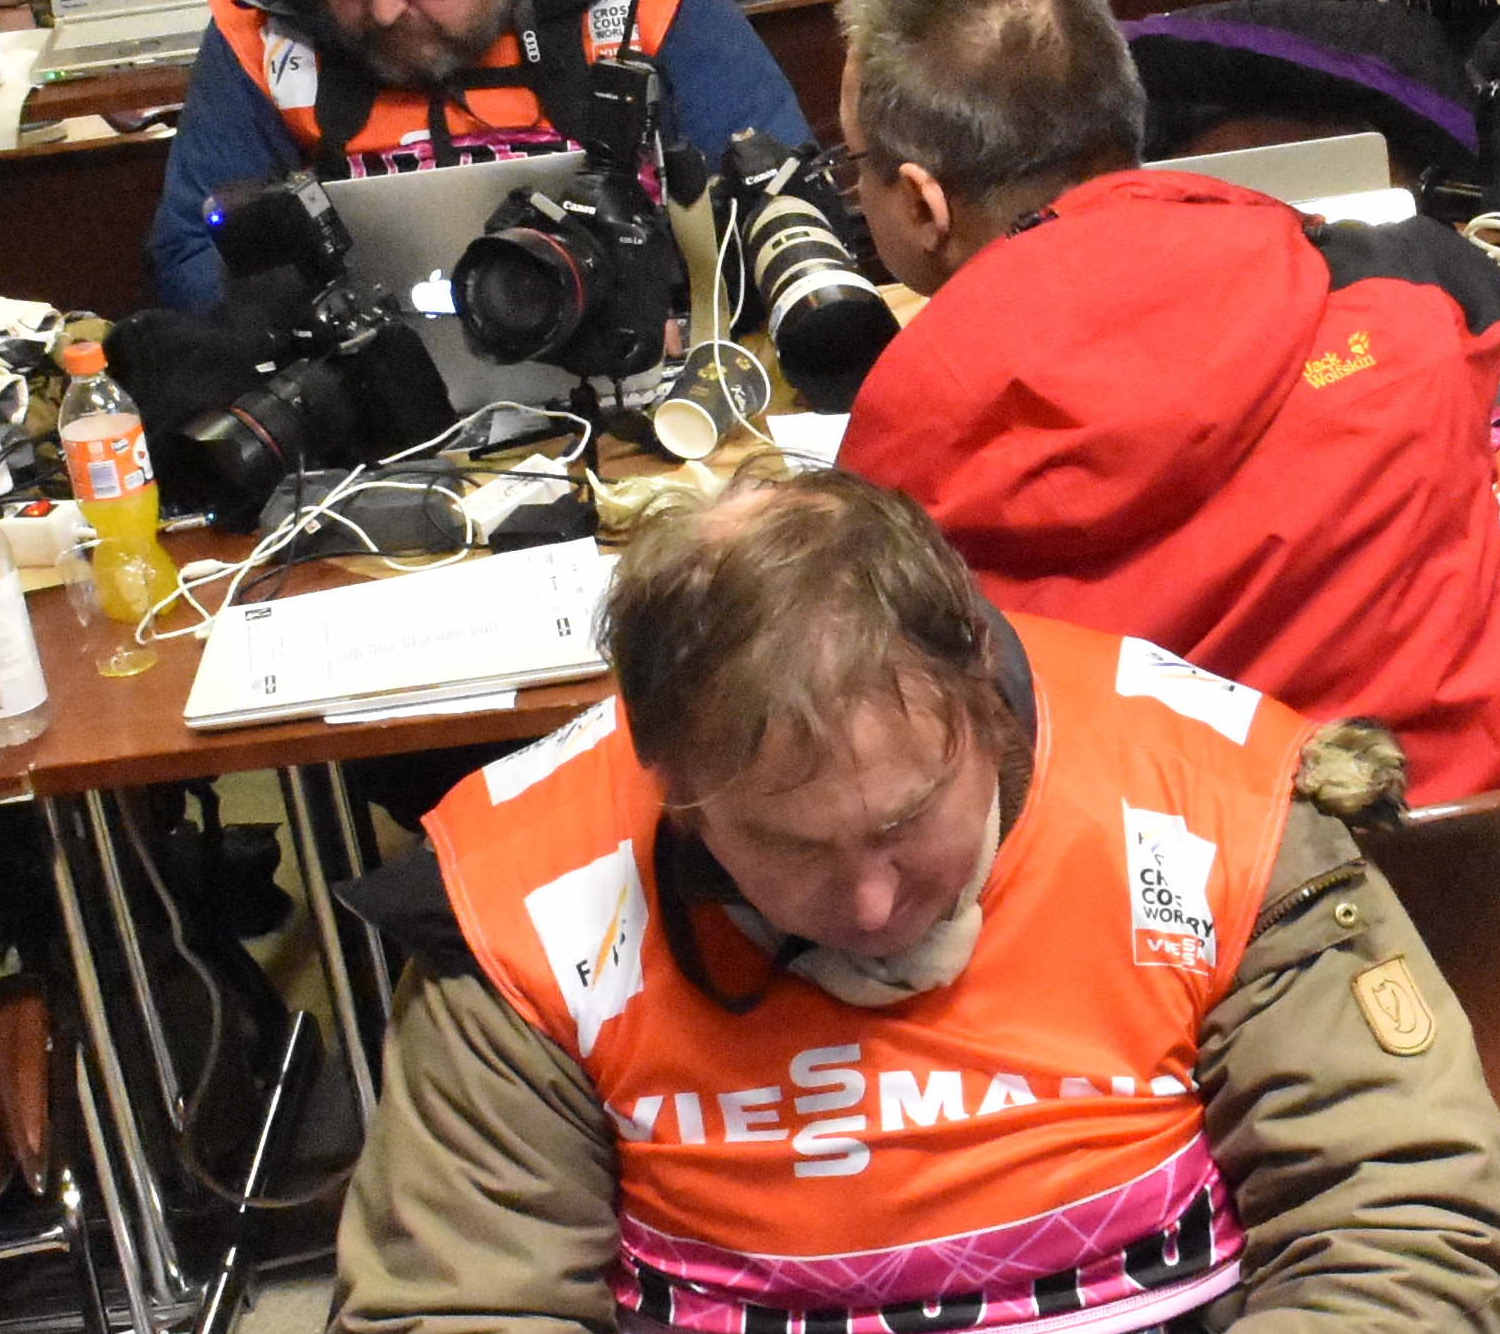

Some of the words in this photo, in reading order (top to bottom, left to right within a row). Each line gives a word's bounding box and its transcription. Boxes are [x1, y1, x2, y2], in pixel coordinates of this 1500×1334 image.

[593, 4, 629, 19] CROS
[744, 167, 779, 185] Canon
[562, 199, 597, 216] Canon
[1302, 351, 1339, 378] Jack
[1306, 352, 1377, 390] Wolfskin
